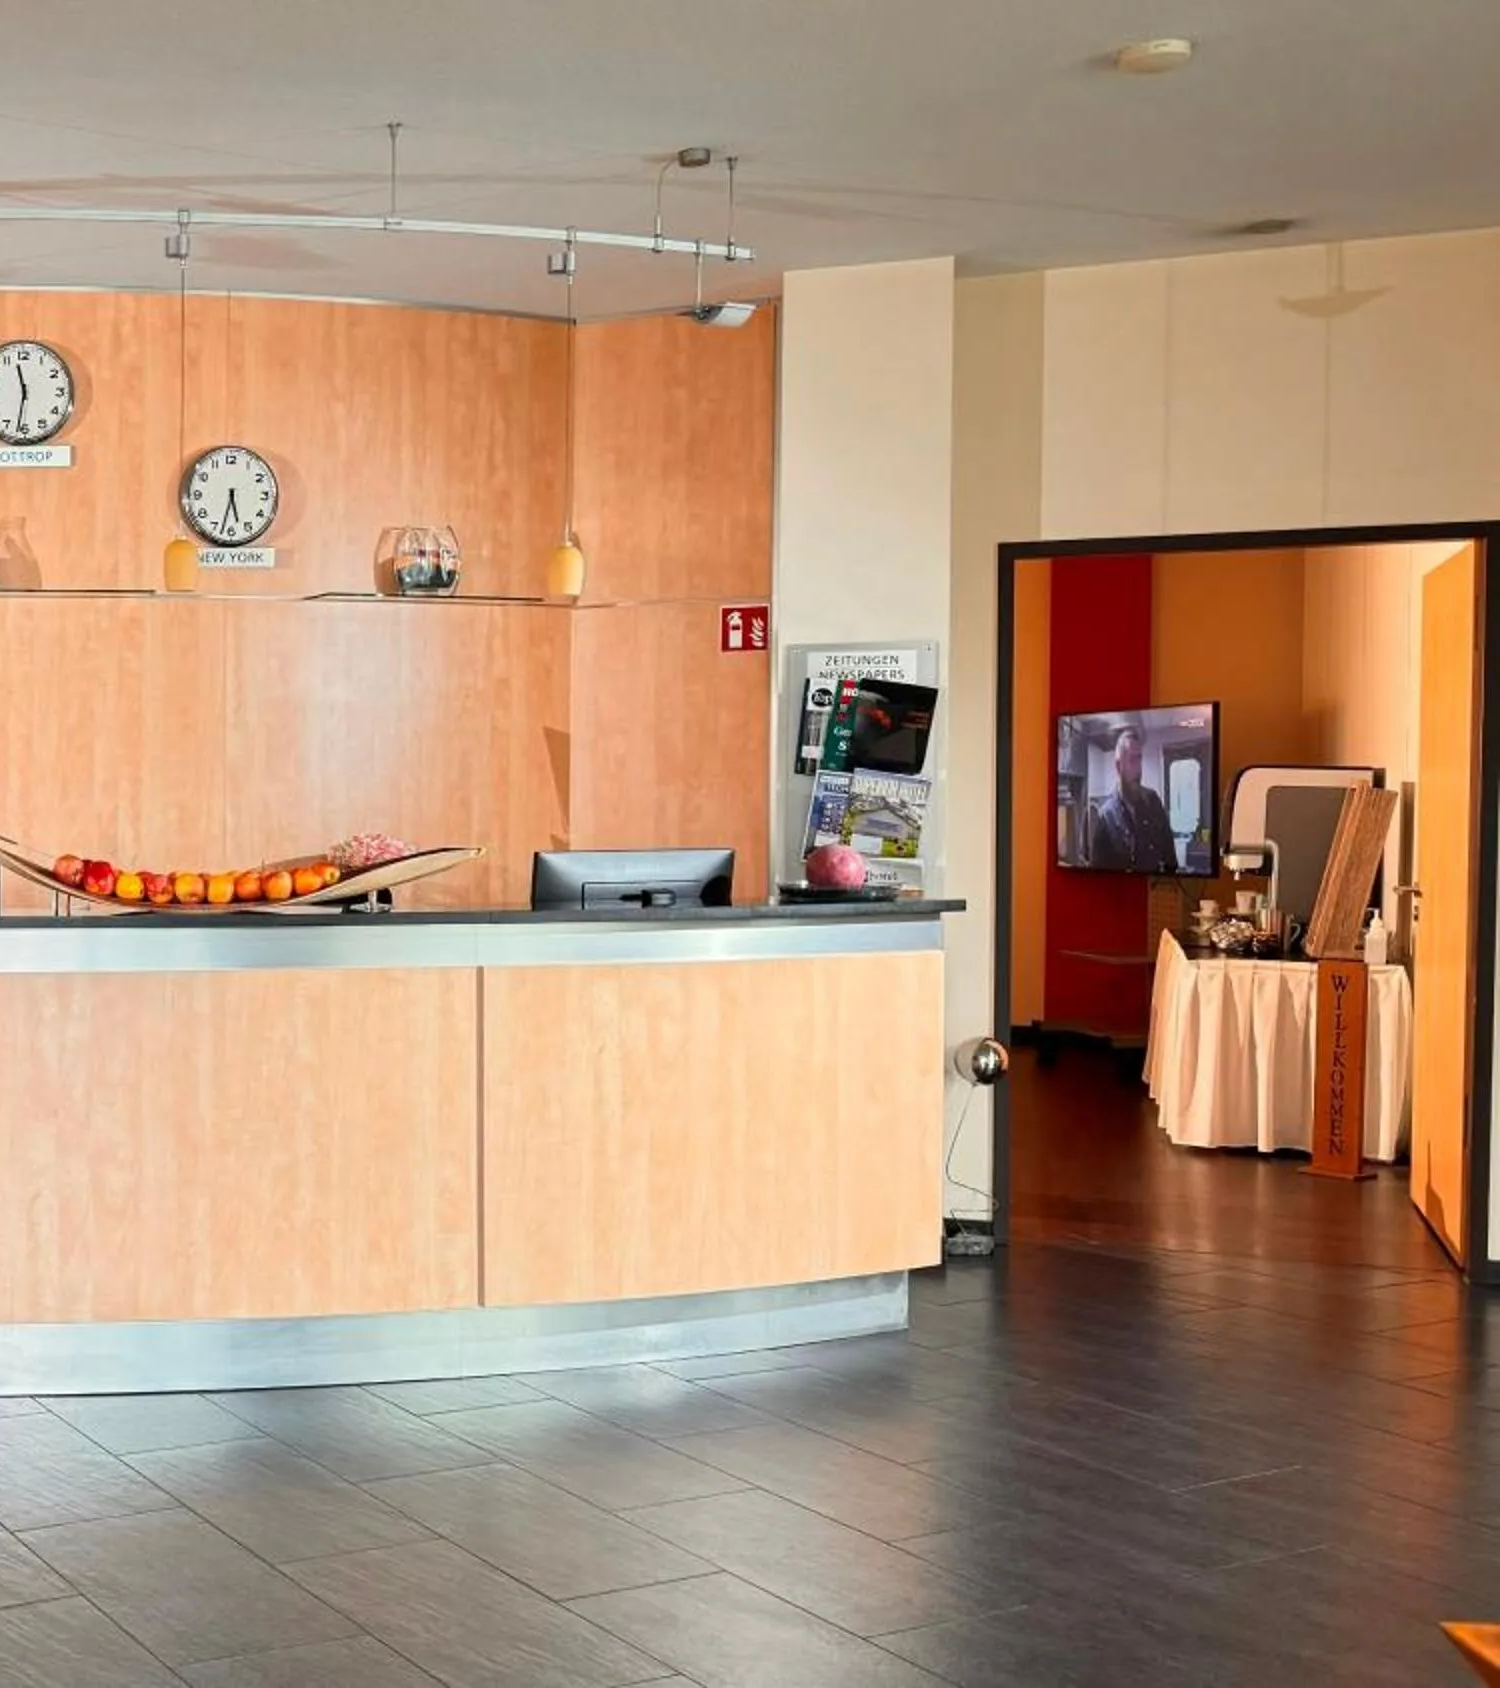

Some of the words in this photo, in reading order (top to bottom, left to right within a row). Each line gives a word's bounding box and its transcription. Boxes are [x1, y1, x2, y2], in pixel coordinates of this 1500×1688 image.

[18, 351, 30, 360] 12
[4, 356, 10, 366] 11
[49, 369, 58, 378] 2
[54, 387, 64, 398] 3
[51, 406, 59, 415] 4
[2, 420, 10, 428] 7
[20, 424, 30, 434] 6
[38, 420, 47, 429] 5
[212, 459, 218, 469] 11
[226, 456, 237, 464] 12
[256, 474, 265, 483] 2
[194, 490, 202, 500] 9
[260, 492, 268, 501] 3
[198, 508, 208, 518] 8
[256, 509, 264, 518] 4
[210, 522, 218, 530] 7
[227, 526, 236, 536] 6
[244, 522, 252, 532] 5
[230, 552, 263, 562] YORK
[825, 656, 899, 666] ZEITUNGEN
[820, 670, 904, 680] NEWSPAPERS
[1329, 975, 1350, 1155] WILLKOMMEN
